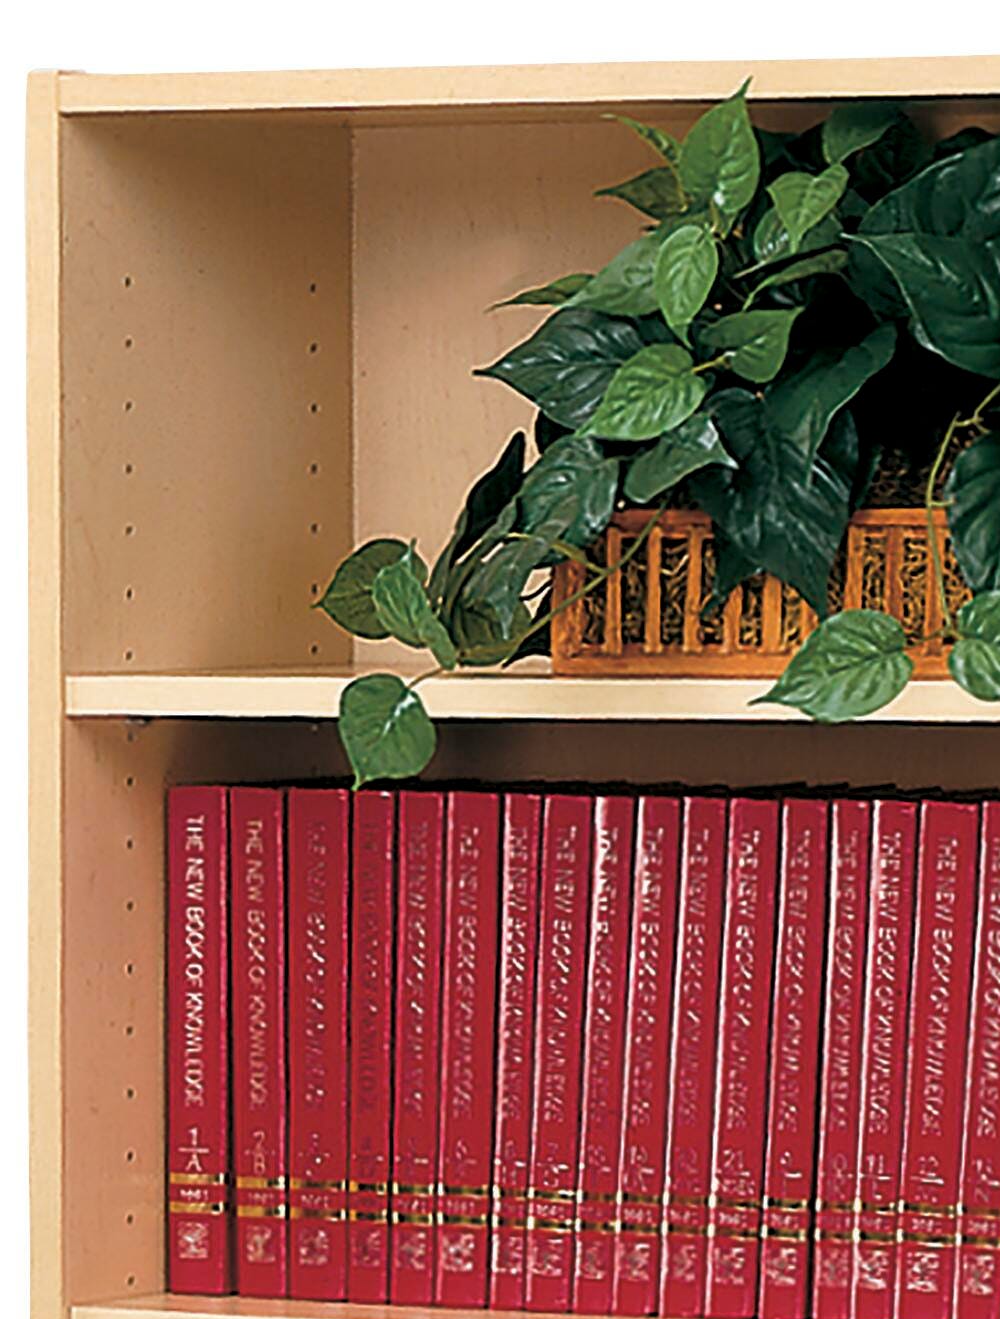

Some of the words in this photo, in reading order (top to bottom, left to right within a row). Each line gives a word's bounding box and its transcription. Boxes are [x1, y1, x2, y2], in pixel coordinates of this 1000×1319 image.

[186, 815, 205, 851] THE
[246, 820, 264, 853] THE
[880, 831, 902, 870] THE
[936, 836, 958, 871] THE
[186, 857, 205, 900] NEW
[246, 859, 265, 902] NEW
[554, 868, 574, 913] NEW
[879, 876, 900, 920] NEW
[934, 876, 956, 922] NEW
[186, 906, 205, 960] BOOK
[248, 909, 266, 963] BOOK
[877, 927, 898, 981] BOOK
[186, 963, 205, 988] OF
[931, 928, 953, 983] BOOK
[185, 992, 204, 1108] KNOWLEDGE
[187, 1127, 198, 1147] 1
